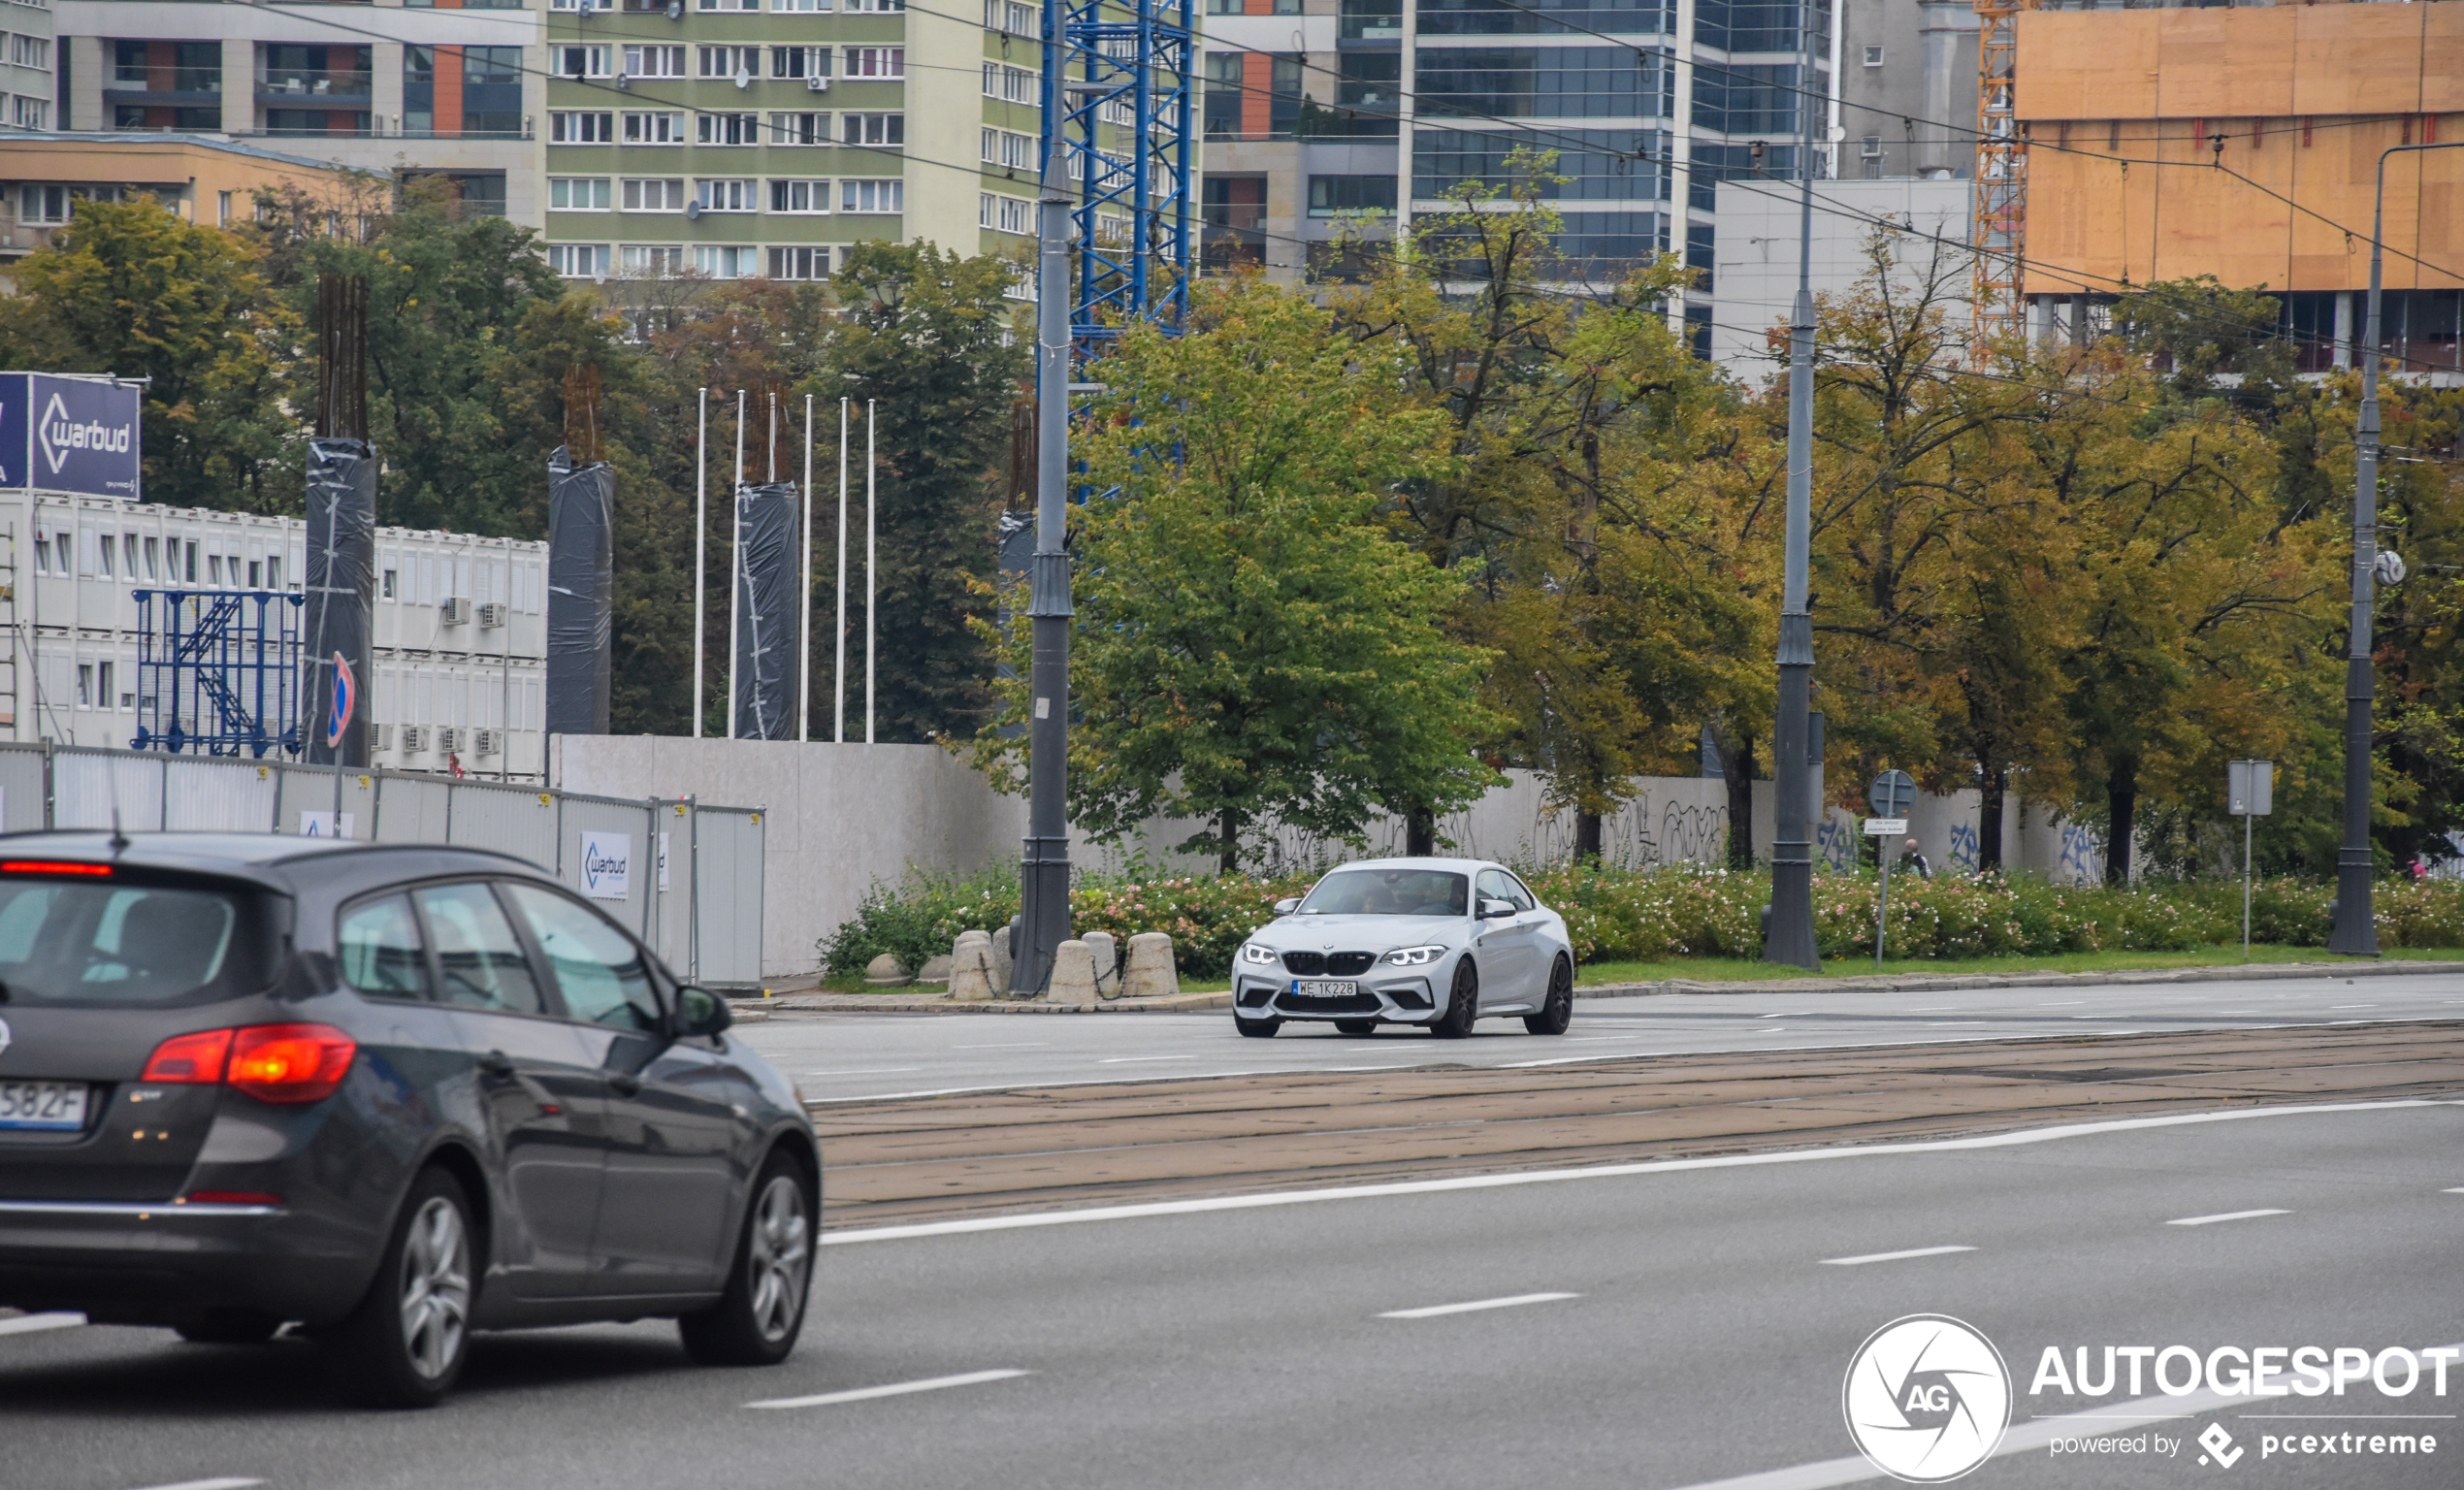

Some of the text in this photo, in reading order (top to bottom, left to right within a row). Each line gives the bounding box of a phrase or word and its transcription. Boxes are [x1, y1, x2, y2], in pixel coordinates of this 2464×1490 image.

[52, 419, 130, 453] warbud
[591, 856, 627, 874] warbud
[1300, 983, 1313, 994] WE
[1319, 983, 1353, 994] 1K228
